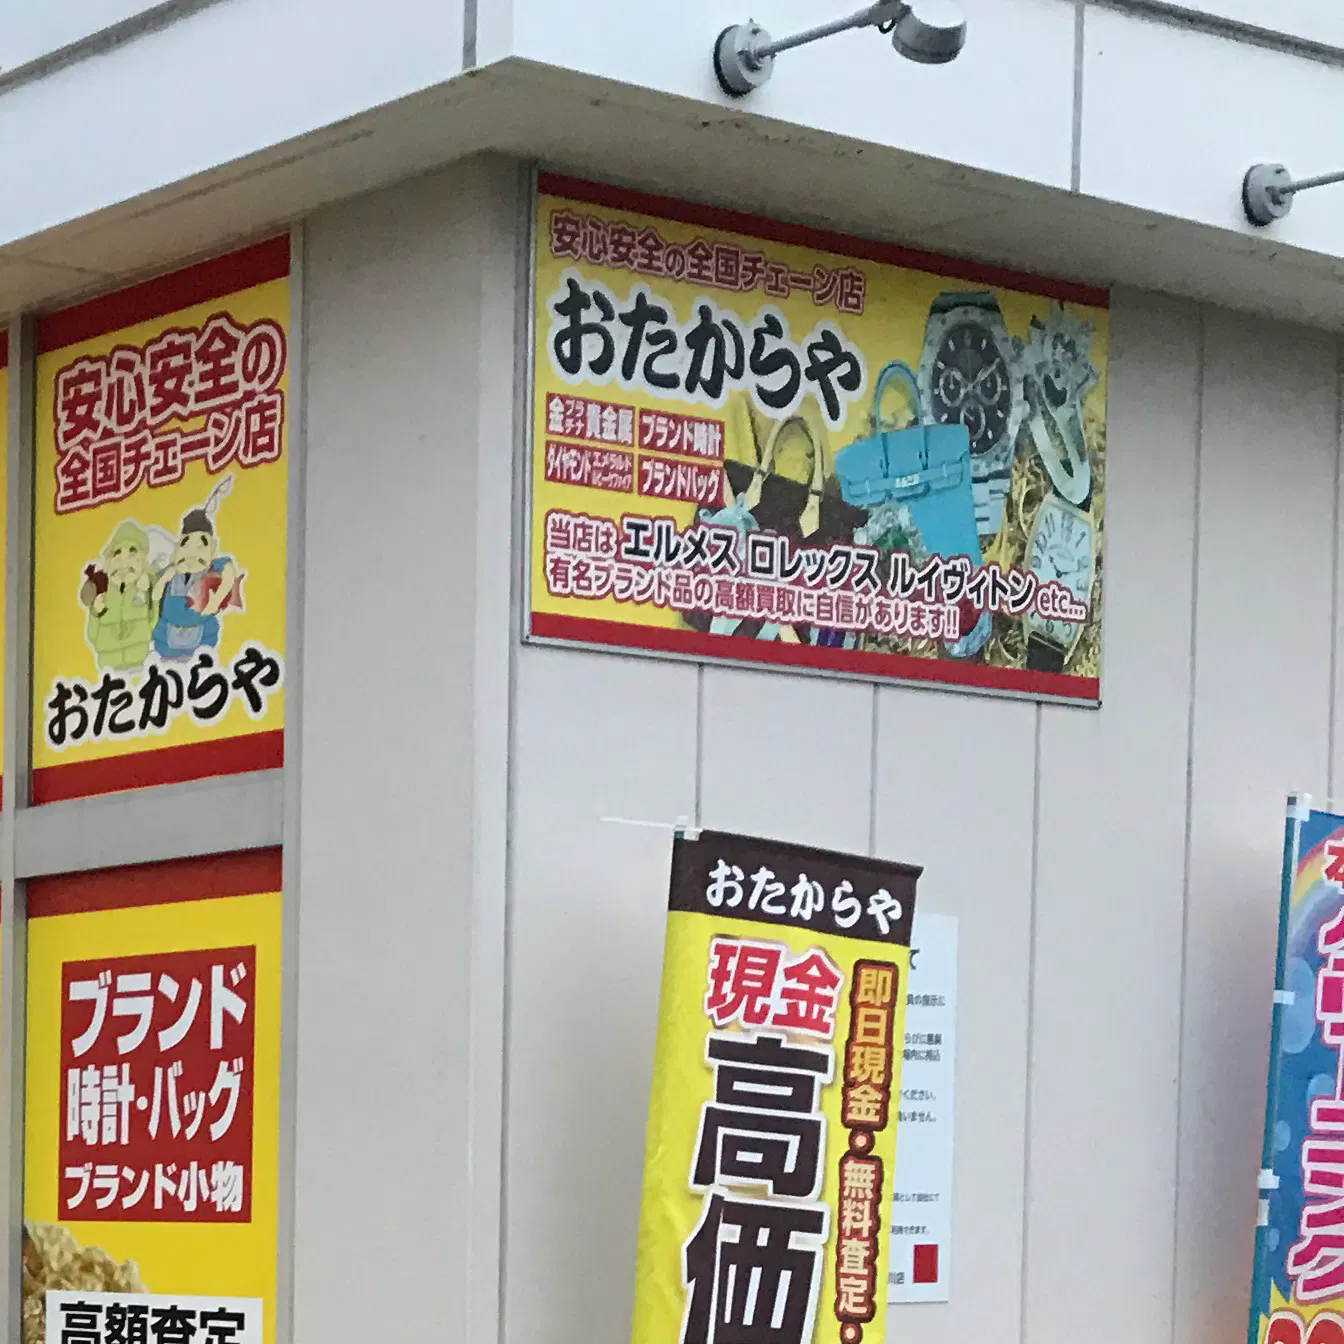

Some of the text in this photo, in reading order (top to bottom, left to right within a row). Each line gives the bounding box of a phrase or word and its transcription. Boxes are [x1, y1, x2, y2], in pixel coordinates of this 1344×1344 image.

[550, 212, 866, 314] 安心安全の全国チェーン店
[57, 314, 286, 448] 安心安全の
[553, 278, 864, 421] おたからや
[57, 391, 284, 514] 全国チェーン店
[548, 396, 564, 433] 金
[642, 414, 722, 457] ブランド時計
[642, 459, 720, 502] ブランドバッグ
[547, 514, 616, 559] 当店は
[623, 518, 738, 571] エルメス
[749, 537, 877, 593] ロレックス
[888, 554, 1034, 613] ルイヴィトン
[47, 646, 281, 746] おたからや
[705, 859, 904, 936] おたからや
[68, 962, 247, 1058] ブランド
[708, 942, 843, 1032] 現金
[66, 1057, 245, 1146] 時計・バッグ
[63, 1160, 243, 1213] ブランド小物
